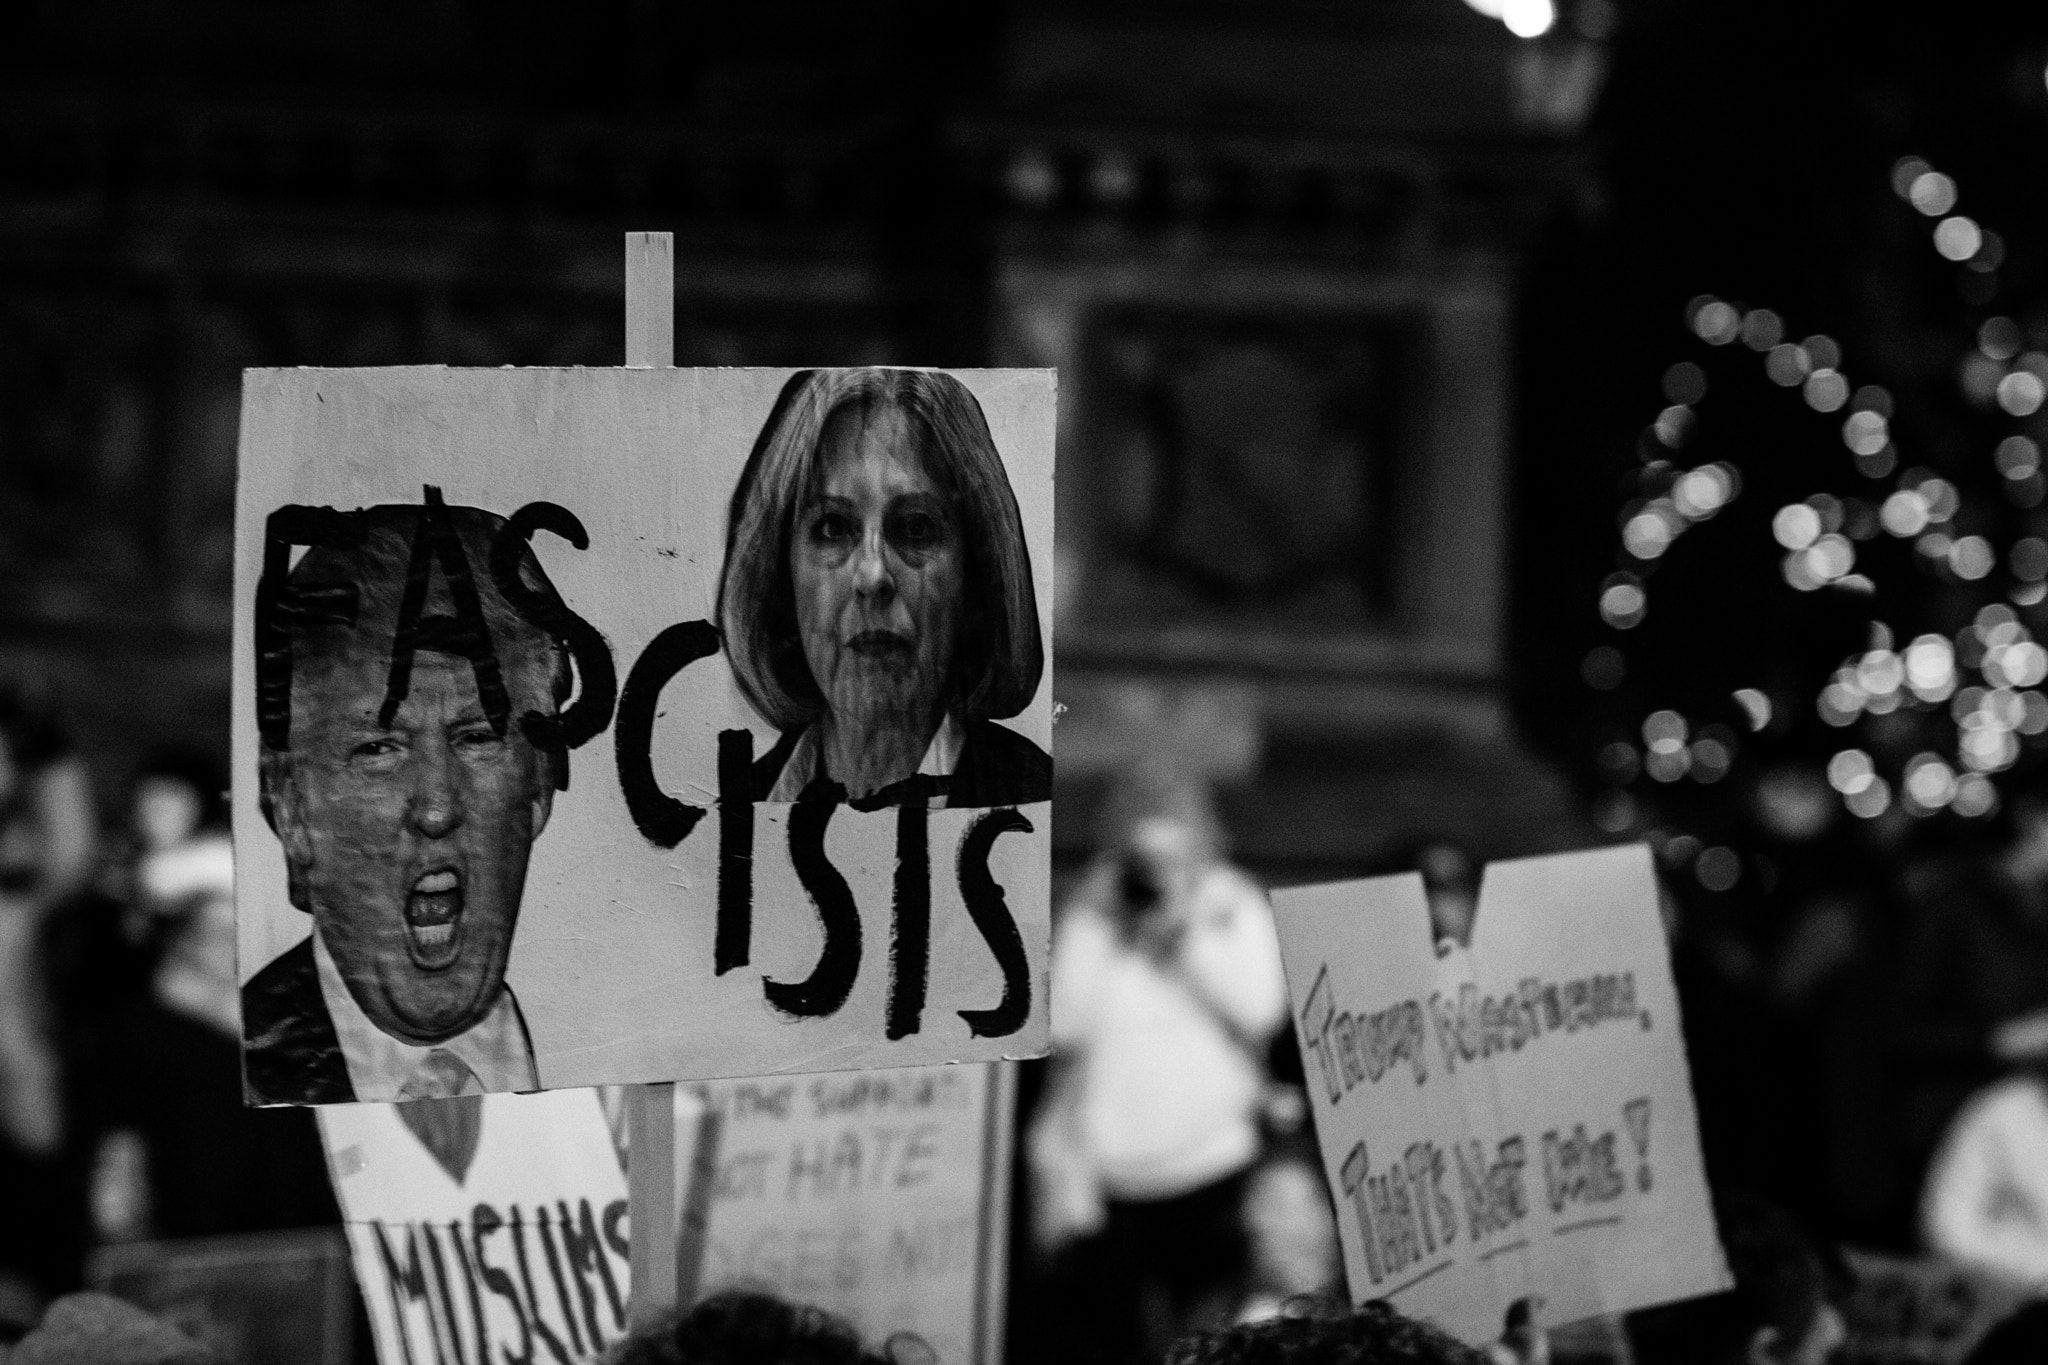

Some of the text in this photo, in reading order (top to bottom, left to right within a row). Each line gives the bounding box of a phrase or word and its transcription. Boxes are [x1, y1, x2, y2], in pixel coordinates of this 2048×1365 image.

[1302, 962, 1428, 1106] TRUMP
[785, 1123, 943, 1204] HATE
[1339, 1138, 1458, 1286] THAT'S
[1453, 1134, 1527, 1242] NOT
